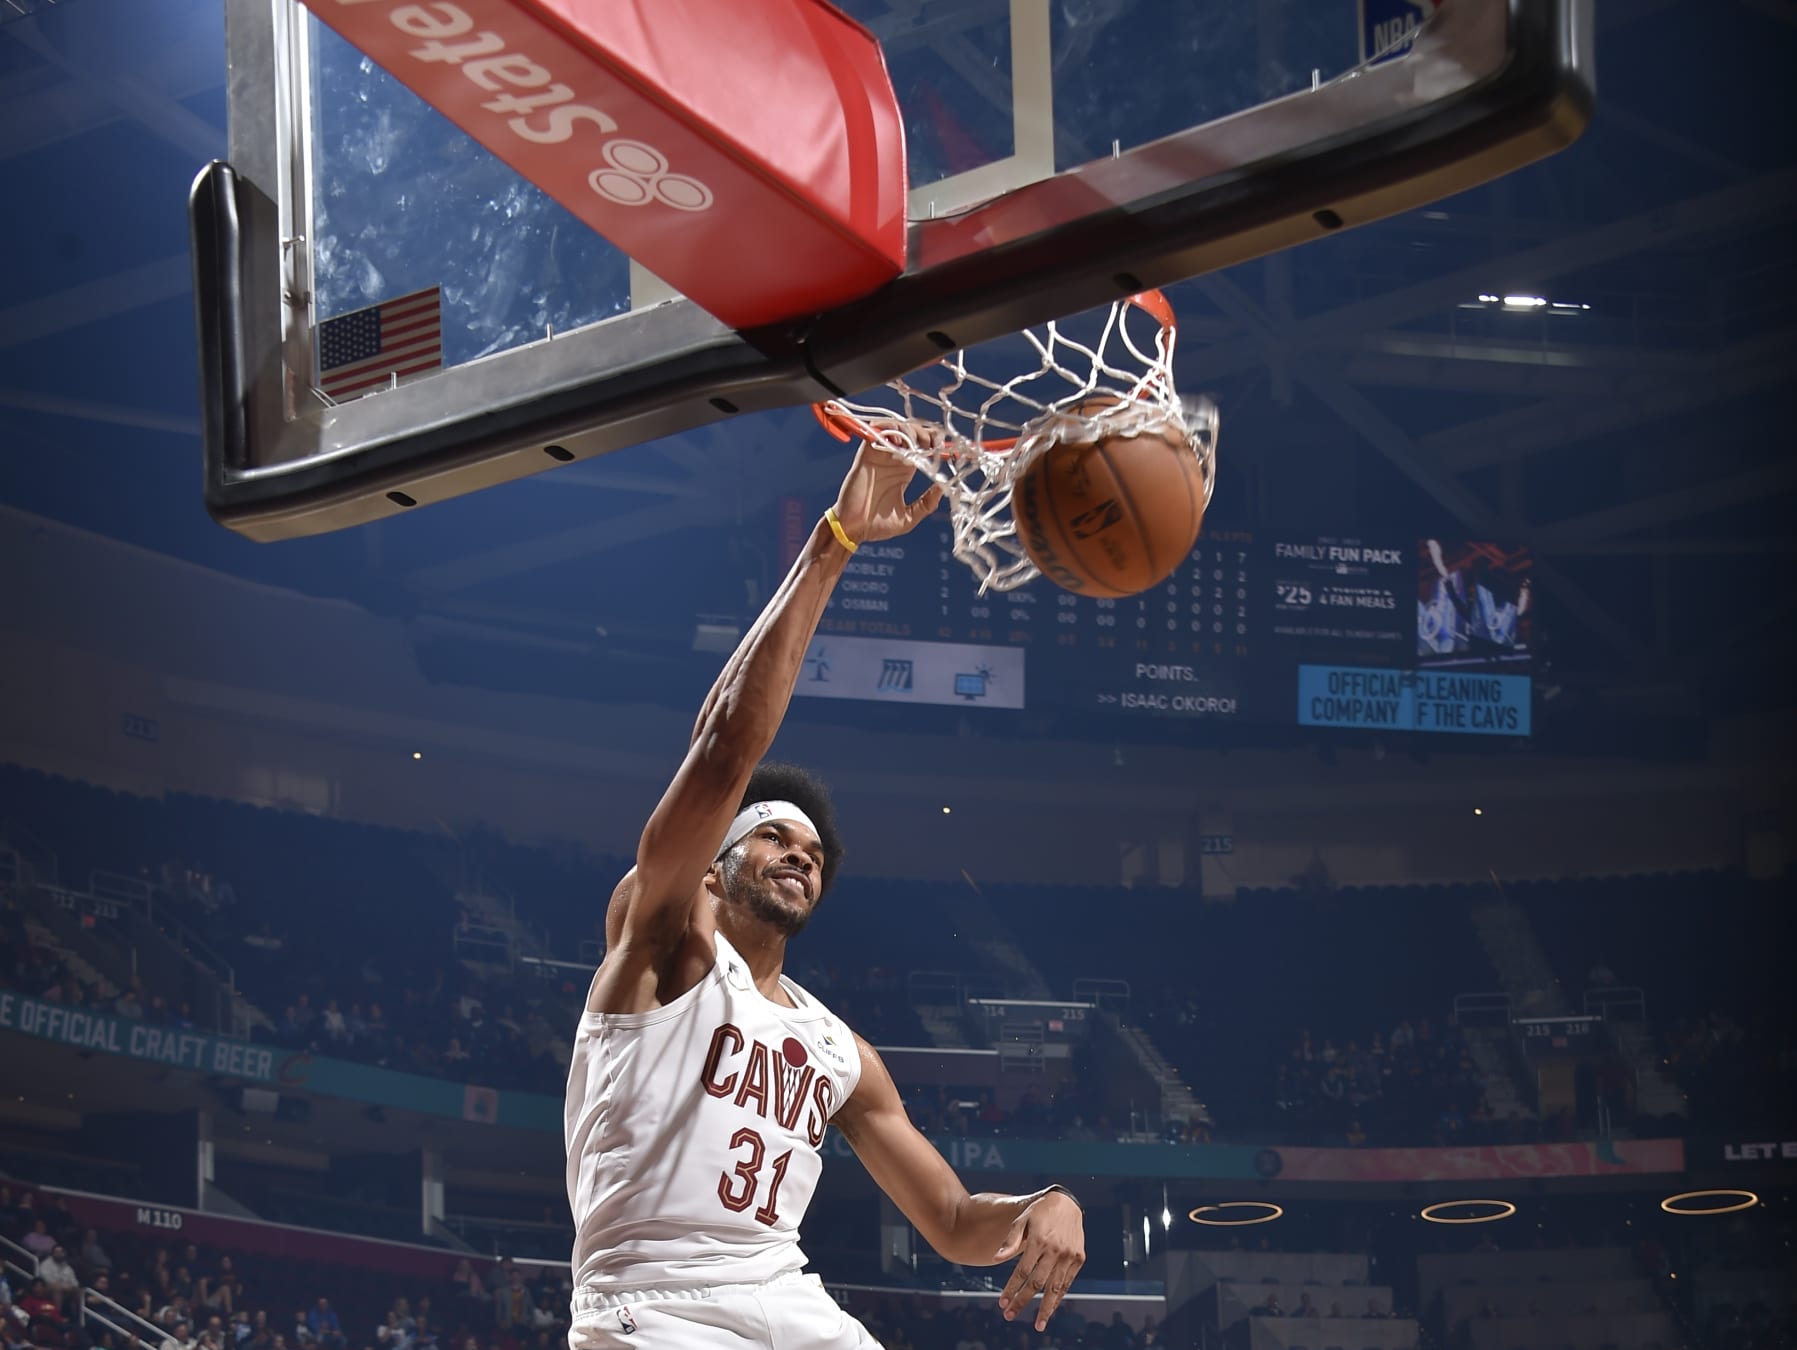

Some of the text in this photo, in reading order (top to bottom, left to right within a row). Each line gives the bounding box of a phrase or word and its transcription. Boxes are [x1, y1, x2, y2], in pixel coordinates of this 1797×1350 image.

[389, 2, 618, 144] State
[1275, 542, 1402, 565] FAMILY FUN PACK
[841, 580, 890, 595] OKORO
[1121, 692, 1169, 710] ISAAC
[1328, 671, 1502, 703] OFFICIA CLEANING
[1311, 697, 1399, 724] COMPANY
[1434, 702, 1467, 728] THE
[1471, 704, 1519, 730] CAVS
[19, 999, 122, 1053] OFFICIAL
[129, 1024, 208, 1069] CRAFT
[213, 1041, 273, 1081] BEER
[700, 1022, 832, 1149] CAVS
[955, 1141, 1004, 1169] IPA
[1724, 1142, 1777, 1160] LET
[717, 1127, 794, 1226] 31
[136, 1208, 183, 1231] M 110
